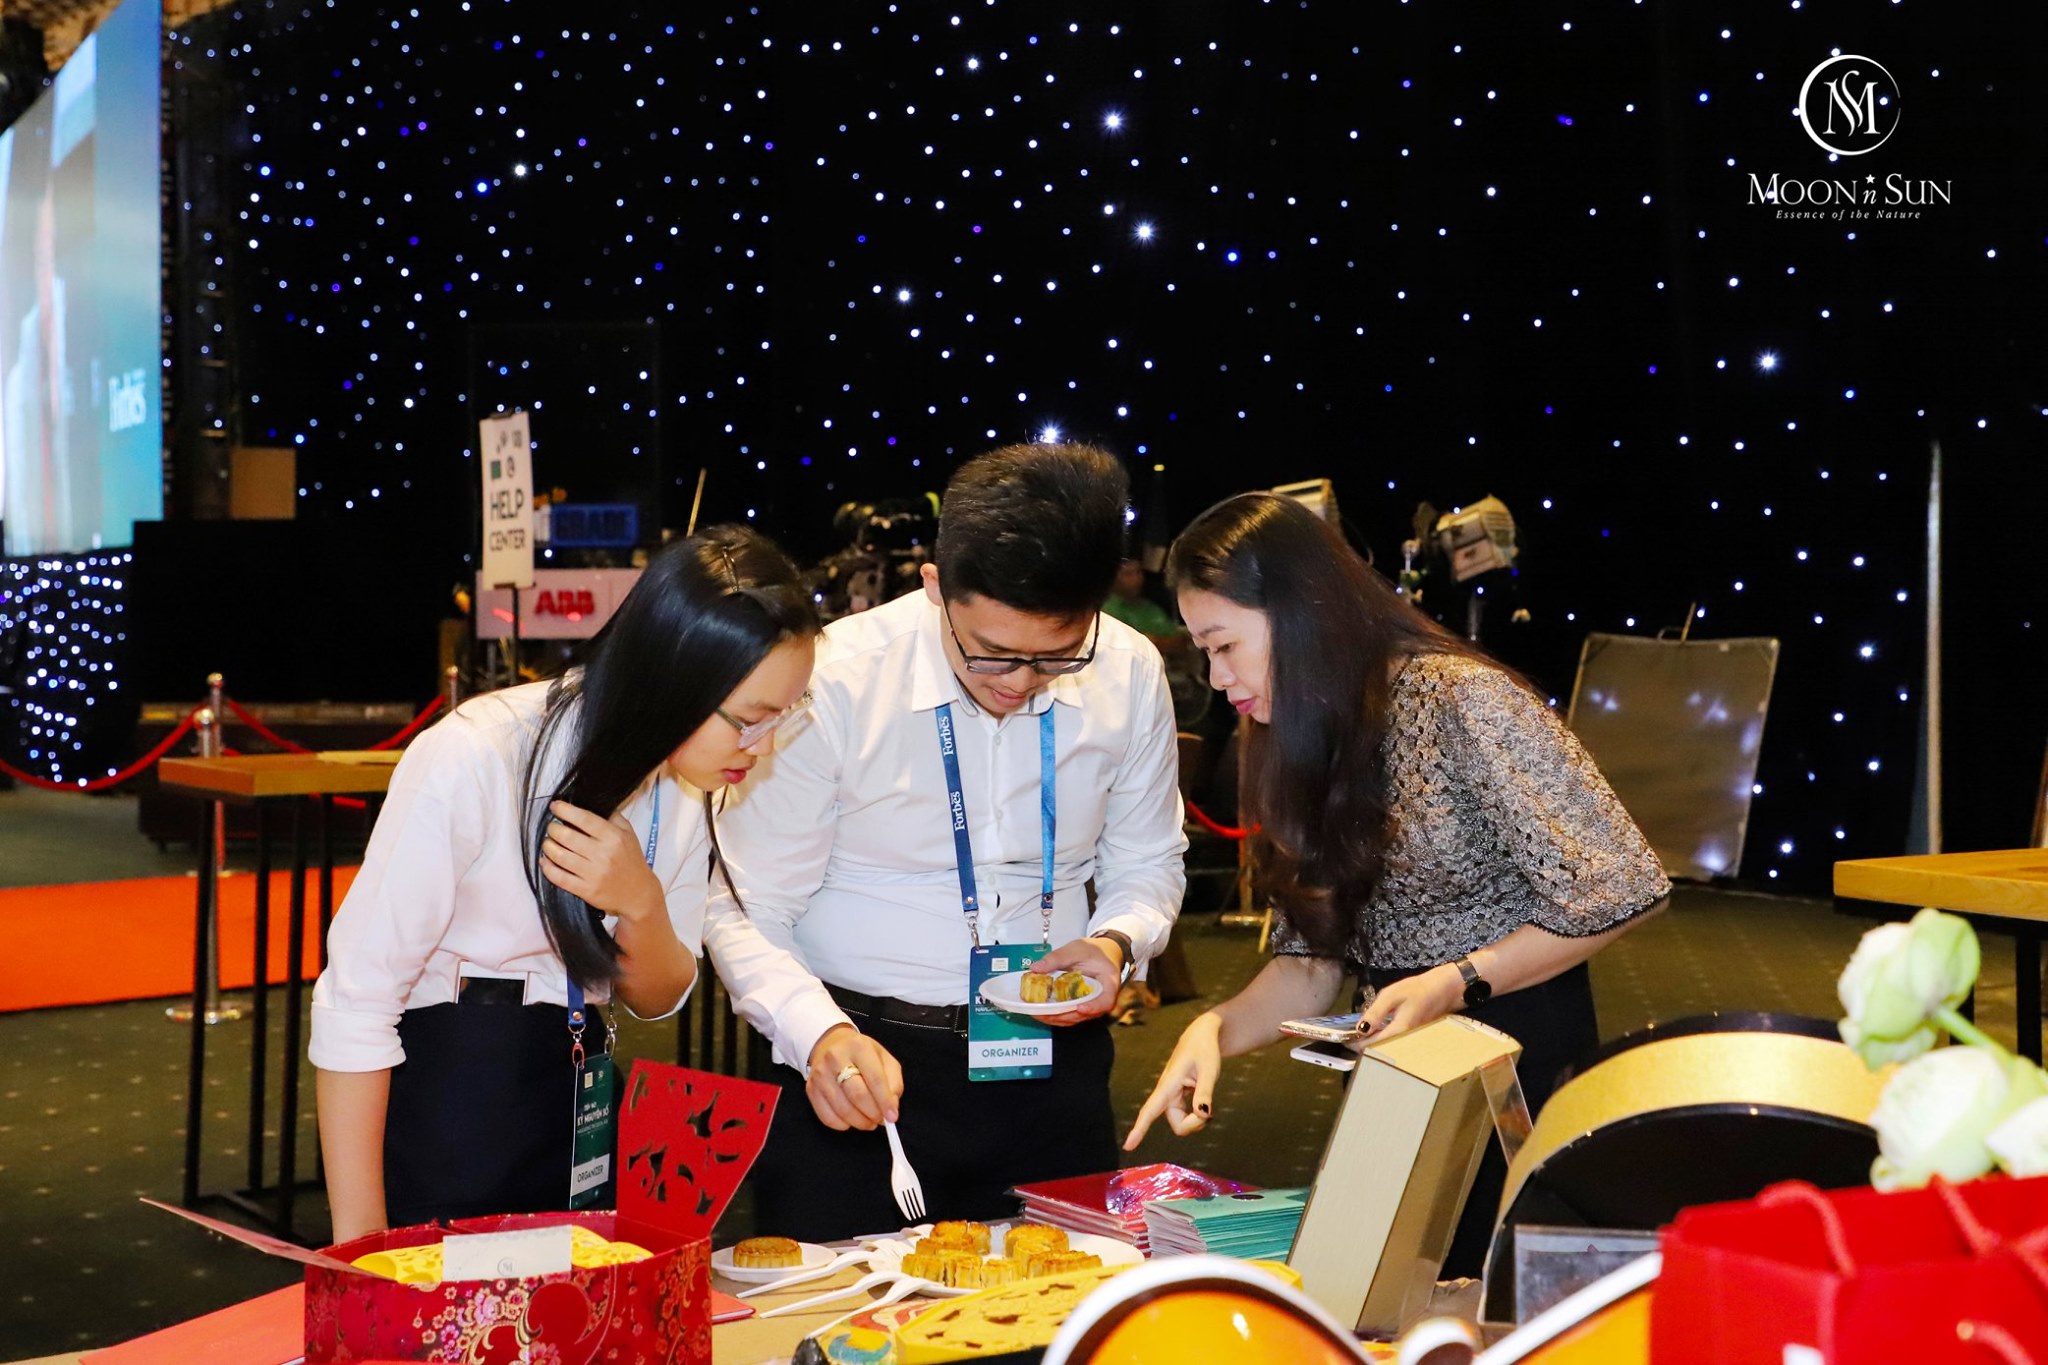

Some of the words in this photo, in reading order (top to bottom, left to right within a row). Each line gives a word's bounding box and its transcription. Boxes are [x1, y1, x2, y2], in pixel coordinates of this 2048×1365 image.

[490, 489, 524, 521] HELP
[489, 528, 526, 551] CENTER
[534, 590, 595, 616] ABB
[940, 716, 954, 756] Forbes
[952, 791, 966, 831] Forbes
[982, 1047, 1039, 1057] ORGANIZER
[577, 1164, 604, 1183] ORGANIZER
